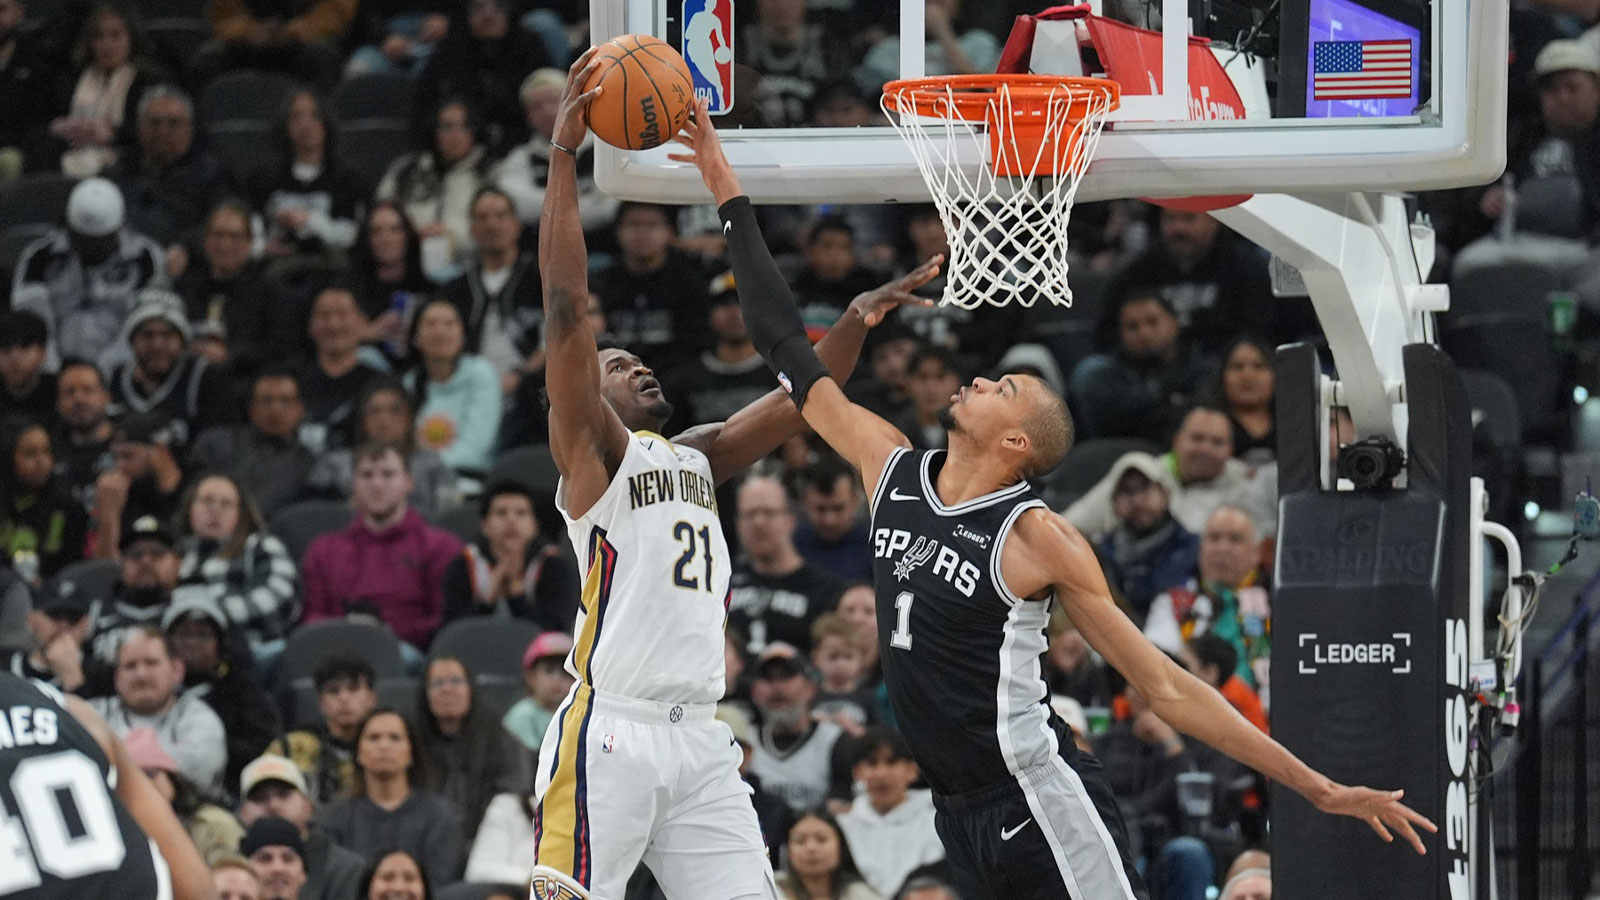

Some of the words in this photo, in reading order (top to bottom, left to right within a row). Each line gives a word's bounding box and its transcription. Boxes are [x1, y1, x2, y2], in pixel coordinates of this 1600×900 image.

[628, 469, 675, 510] NEW
[672, 519, 714, 594] 21
[958, 527, 985, 545] LEDGER
[874, 527, 981, 598] SPURS
[889, 590, 915, 651] 1
[1314, 643, 1396, 664] LEDGER
